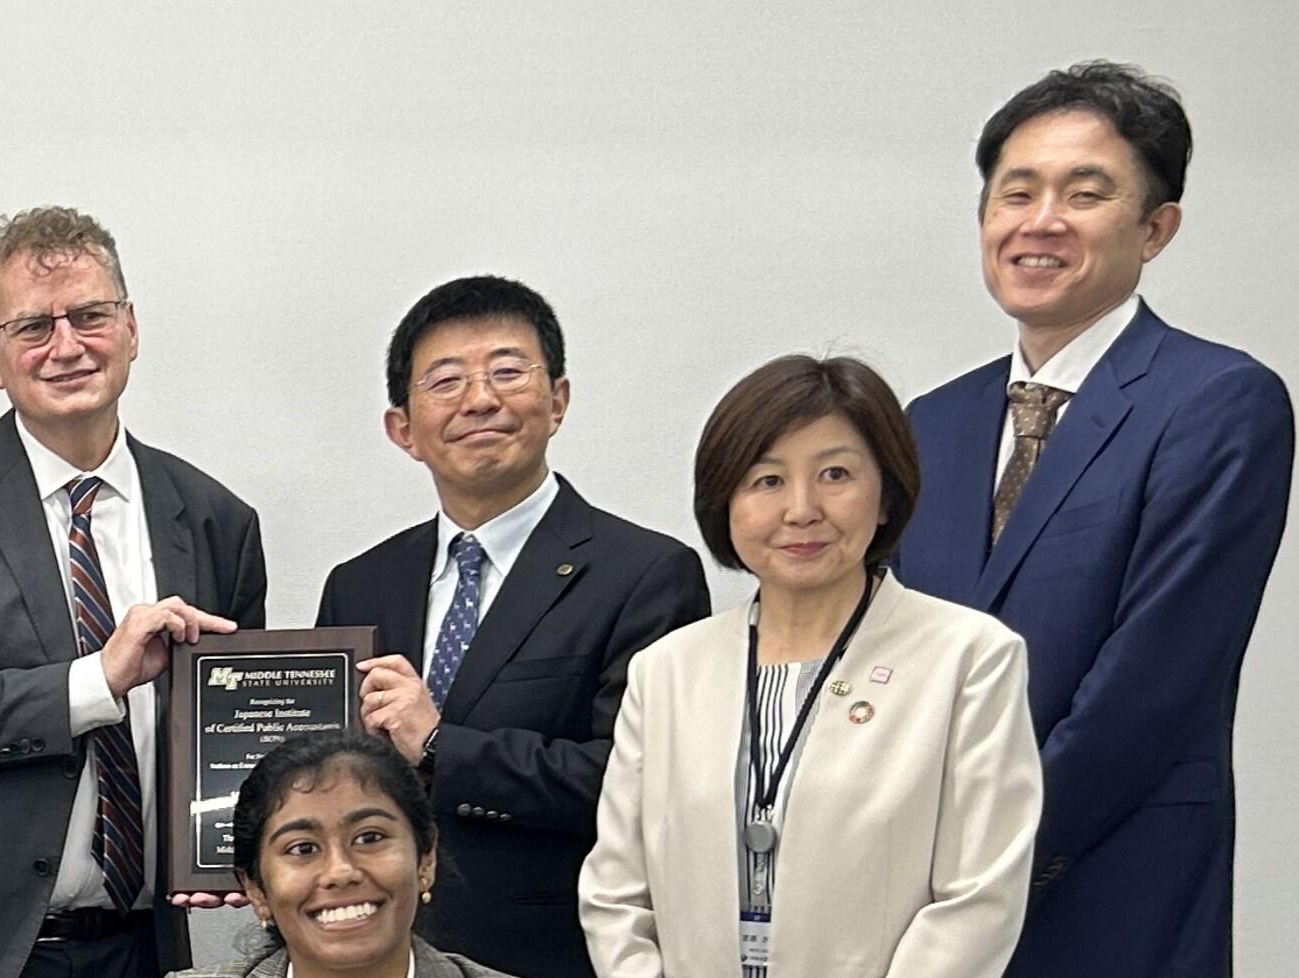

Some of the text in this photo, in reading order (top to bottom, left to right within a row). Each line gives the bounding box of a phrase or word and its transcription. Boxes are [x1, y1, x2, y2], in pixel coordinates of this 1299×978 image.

[244, 669, 336, 680] MIDDLE TENNESSEE
[275, 679, 334, 687] UNIVERSITY
[234, 709, 311, 720] Japanese Institute
[205, 724, 217, 733] of
[217, 723, 255, 733] Certified
[256, 723, 284, 732] Public
